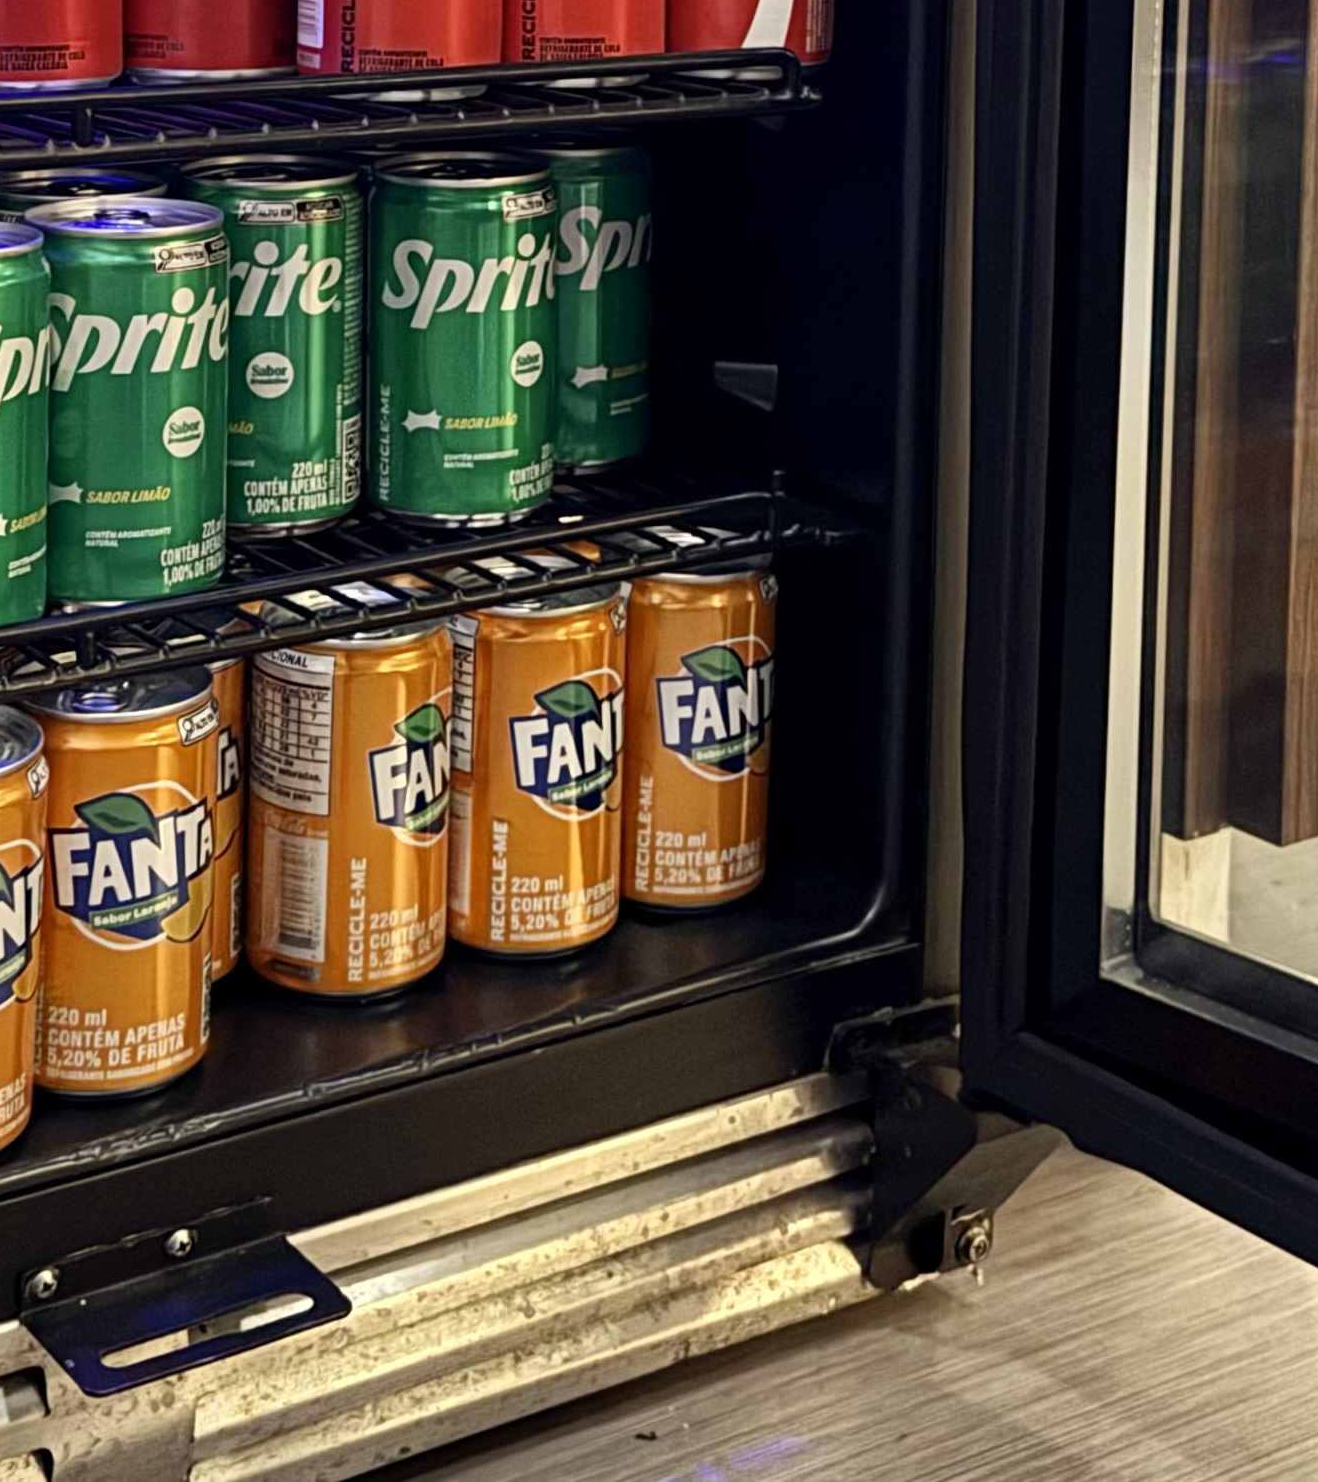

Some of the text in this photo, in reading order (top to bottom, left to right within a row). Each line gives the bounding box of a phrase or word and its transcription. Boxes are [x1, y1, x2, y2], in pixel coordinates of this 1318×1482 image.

[383, 233, 555, 330] Sprit
[250, 363, 288, 378] Sabor
[292, 463, 313, 477] 220
[86, 486, 171, 504] SABOR LIMÃO
[244, 477, 327, 497] CONTÉM APENAS
[298, 492, 327, 510] FRUTA
[635, 775, 653, 892] RECICLE-ME
[656, 832, 706, 848] 220 ml
[51, 803, 213, 907] FANTA
[655, 846, 717, 865] CONTÉM
[491, 821, 508, 941] RECICLE-ME
[511, 874, 563, 893] 220 ml
[654, 866, 725, 883] 5,20% DE
[511, 891, 574, 913] CONTÉM
[349, 857, 367, 982] RECICLE-ME
[370, 910, 398, 928] 220
[511, 912, 559, 929] 5,20%
[48, 1006, 107, 1026] 220 ml
[48, 1014, 185, 1048] CONTÉM APENAS
[47, 1034, 185, 1067] 5,20% DE FRUTA
